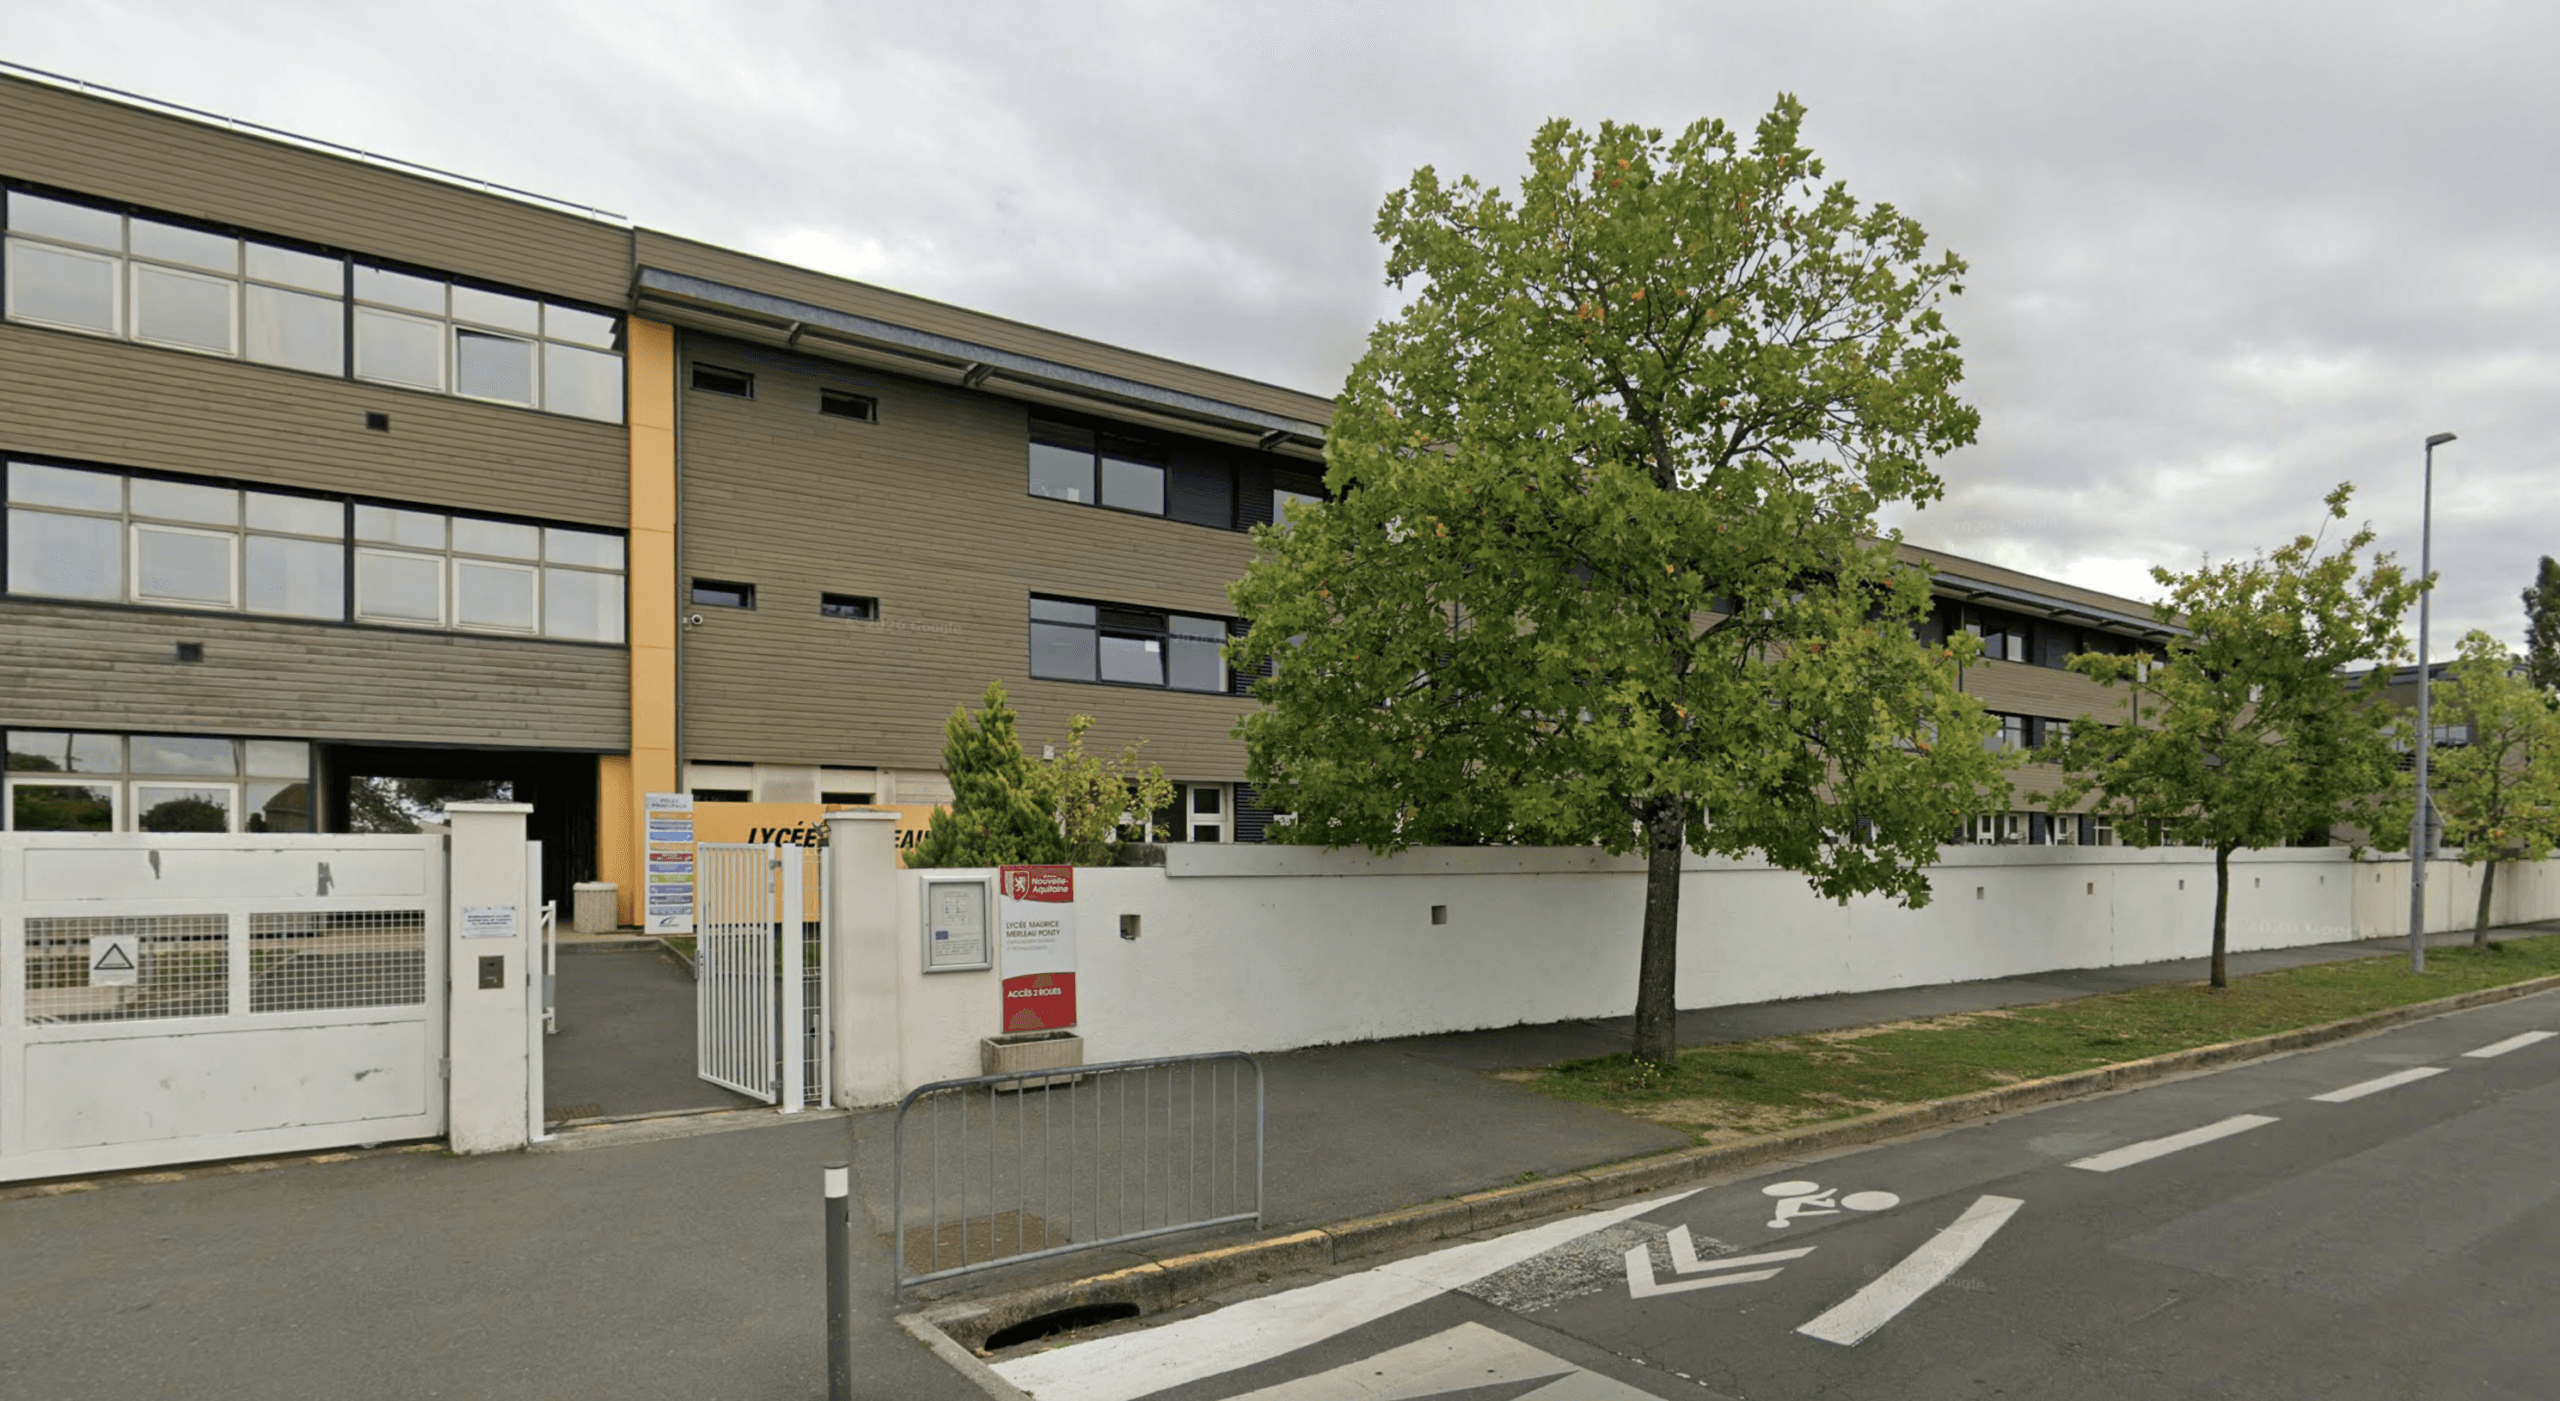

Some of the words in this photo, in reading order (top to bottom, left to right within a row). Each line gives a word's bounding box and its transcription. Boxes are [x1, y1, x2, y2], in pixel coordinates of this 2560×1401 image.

[747, 820, 818, 848] LYCÉE
[1032, 885, 1069, 895] Aquitaine
[1006, 919, 1027, 930] LYCÉE
[1028, 919, 1060, 929] MAURICE
[1006, 929, 1037, 938] MERLEAU
[1038, 928, 1061, 938] PONTY
[1007, 987, 1033, 998] ACCÈS
[1039, 986, 1062, 997] ROUES
